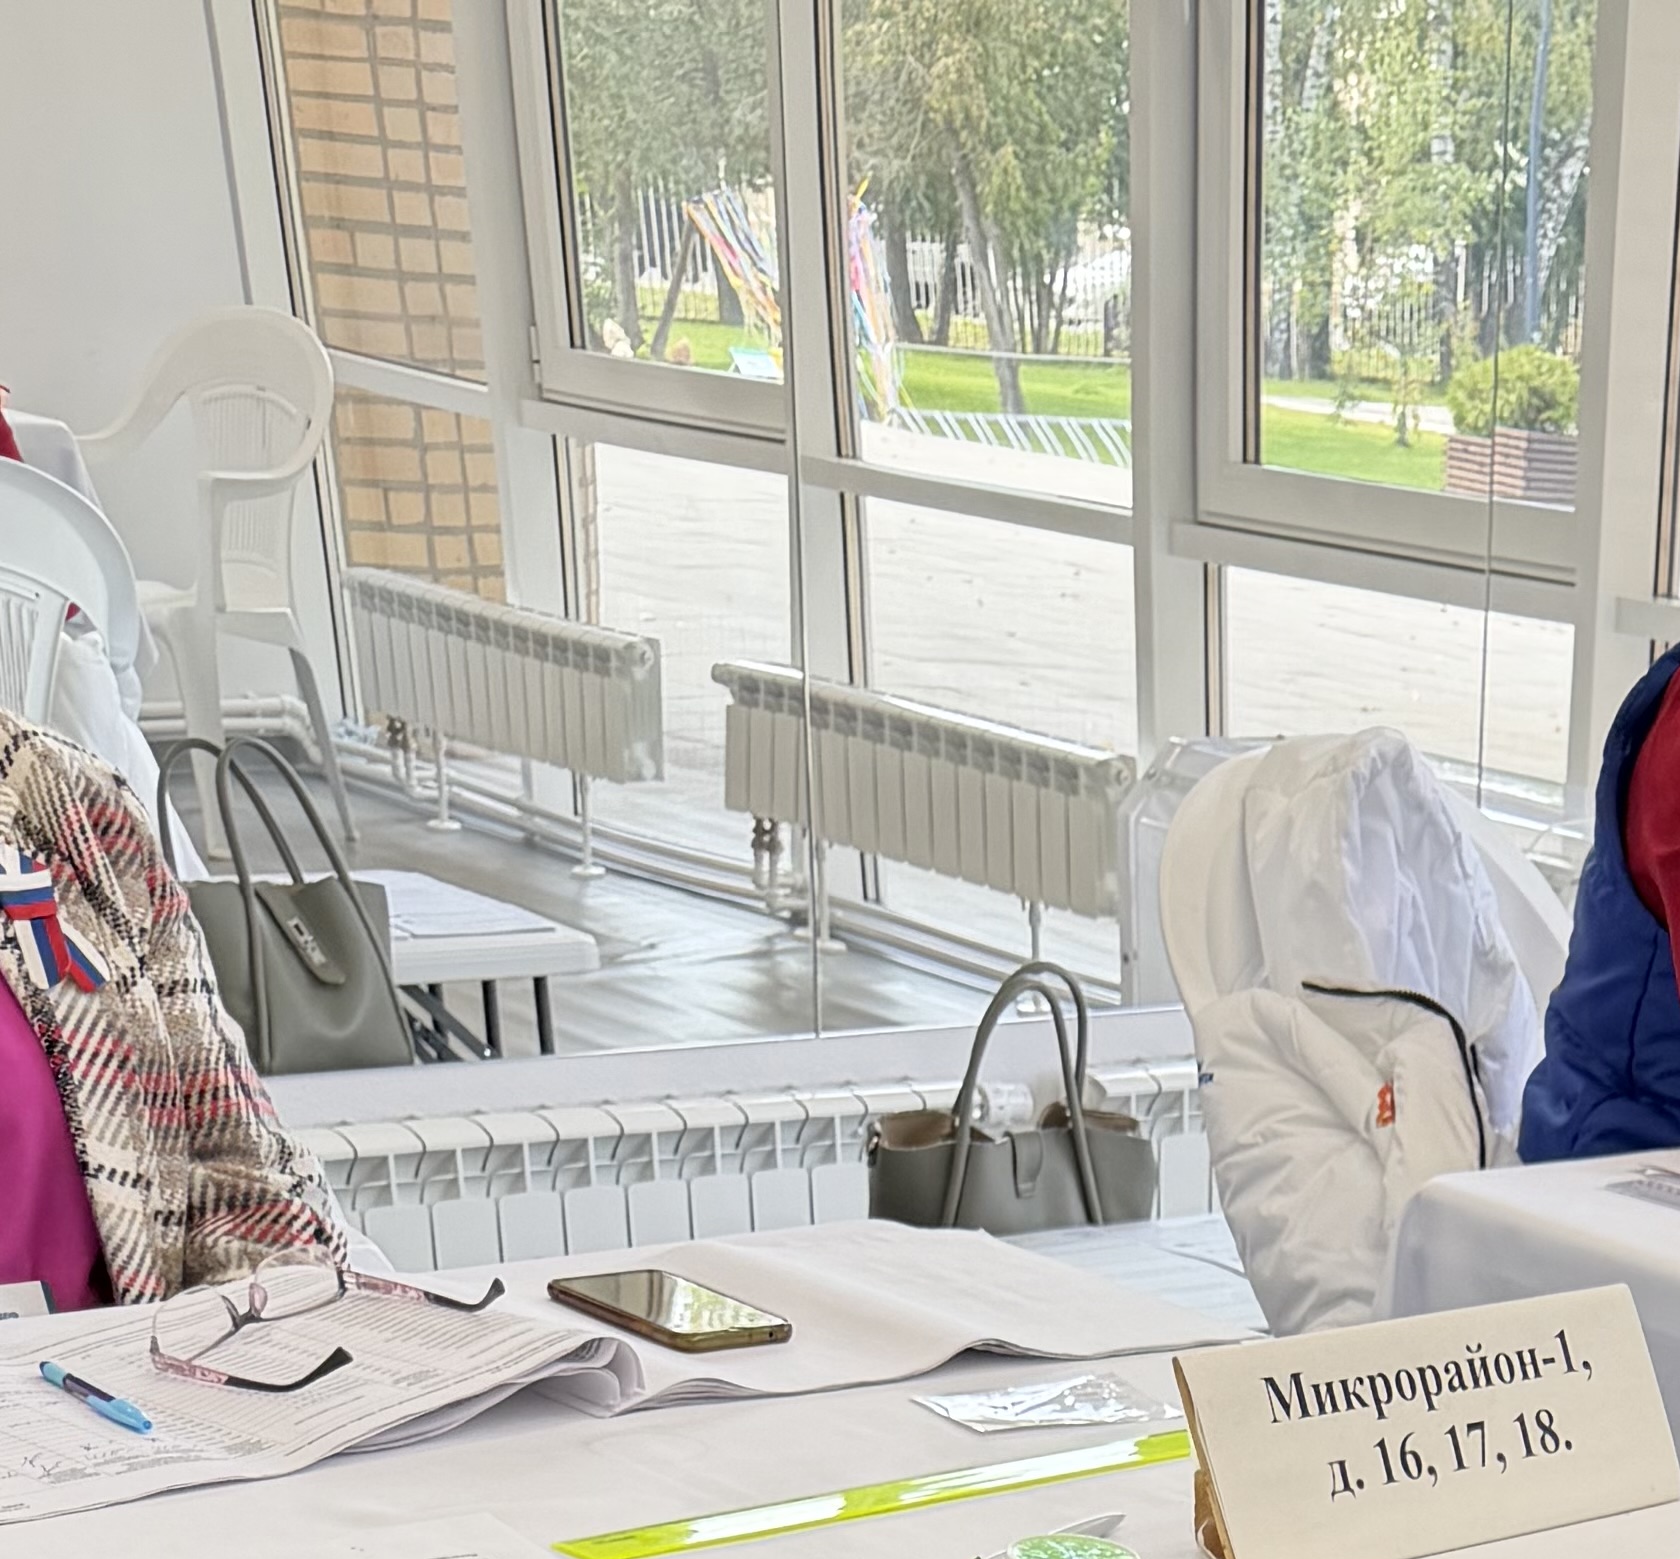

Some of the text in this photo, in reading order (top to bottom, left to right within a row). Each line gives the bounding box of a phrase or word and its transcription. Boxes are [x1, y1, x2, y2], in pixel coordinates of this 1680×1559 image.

[1259, 1328, 1594, 1425] Микрорайон-1,
[1327, 1408, 1574, 1501] д. 16, 17, 18.
